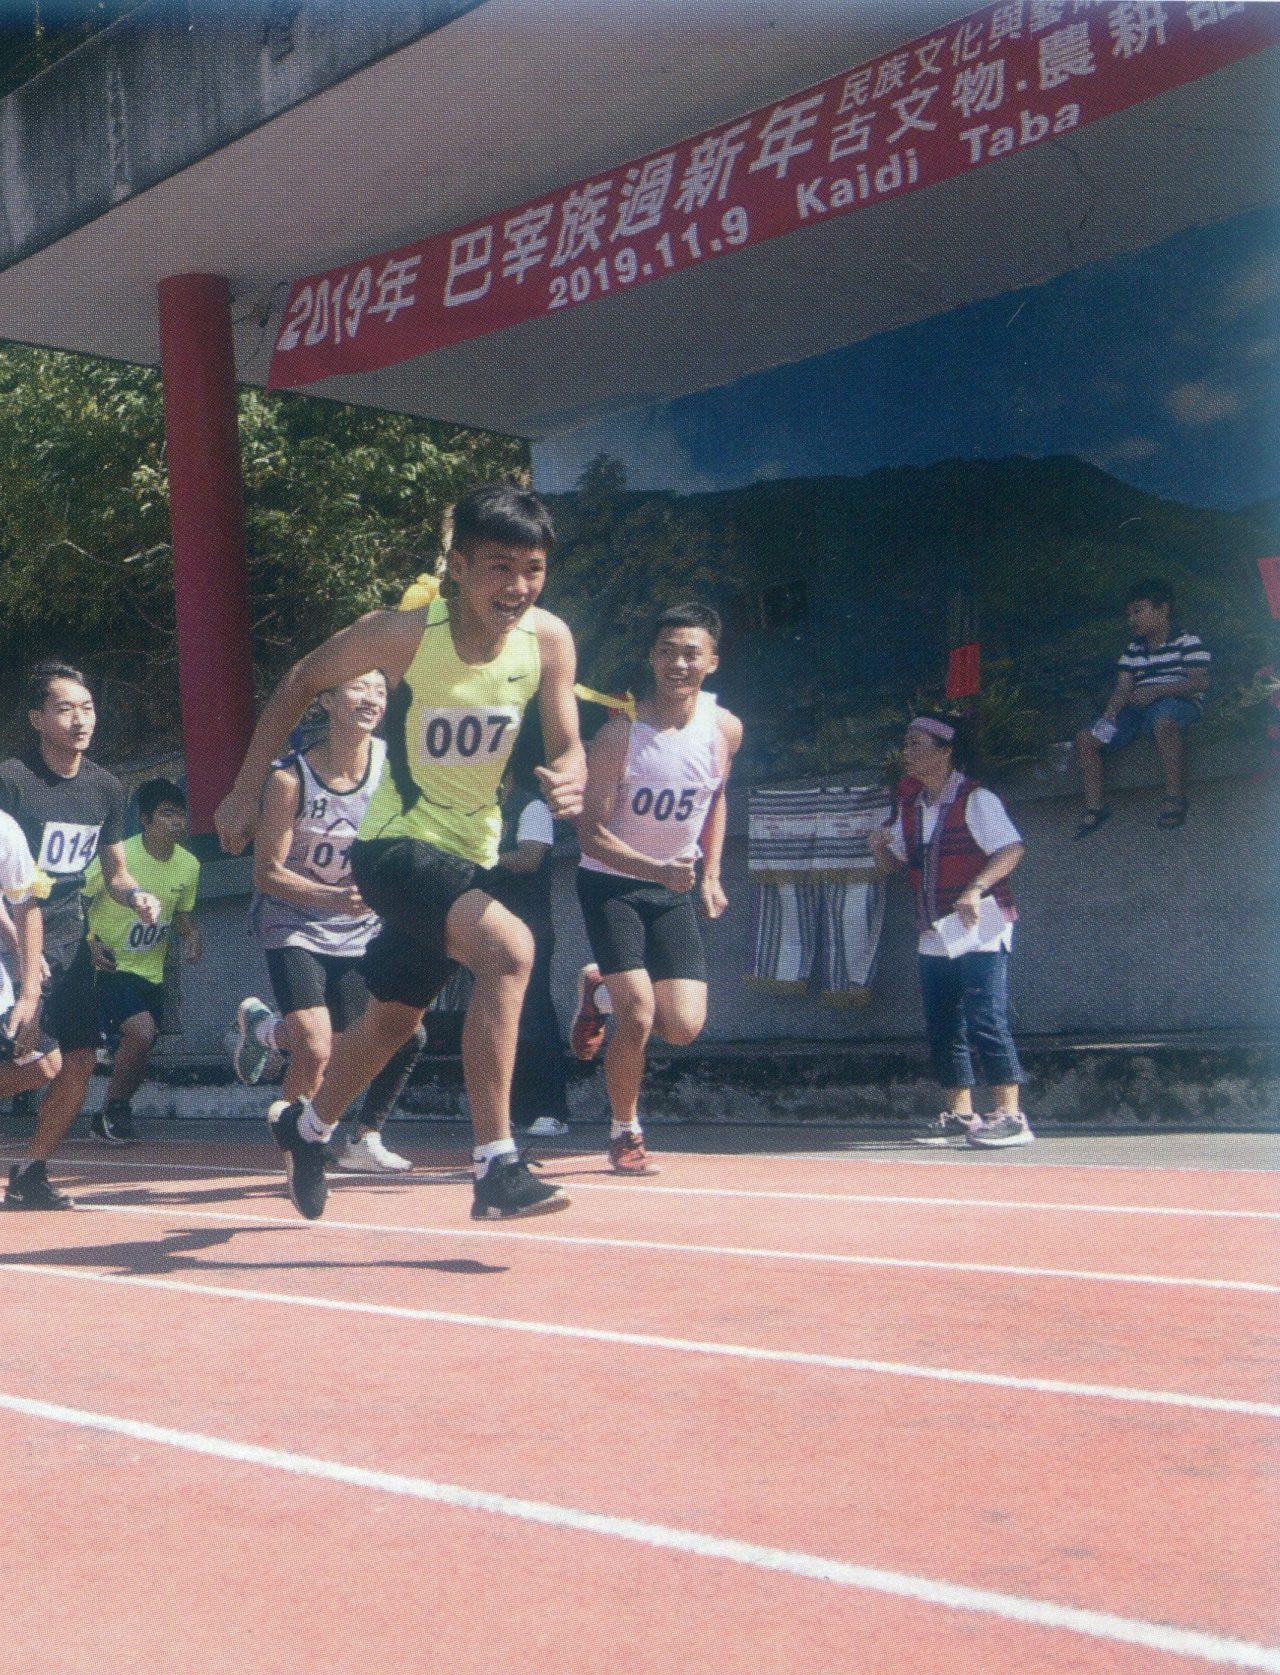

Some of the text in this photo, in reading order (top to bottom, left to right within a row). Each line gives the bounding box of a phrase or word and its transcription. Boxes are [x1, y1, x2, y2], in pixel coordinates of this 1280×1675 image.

[276, 94, 822, 351] 2019年 巴宰族過新年
[548, 102, 1080, 309] 2019.11.9 Kaidi Taba
[426, 715, 512, 758] 007
[632, 787, 697, 822] 005
[47, 830, 97, 865] 014
